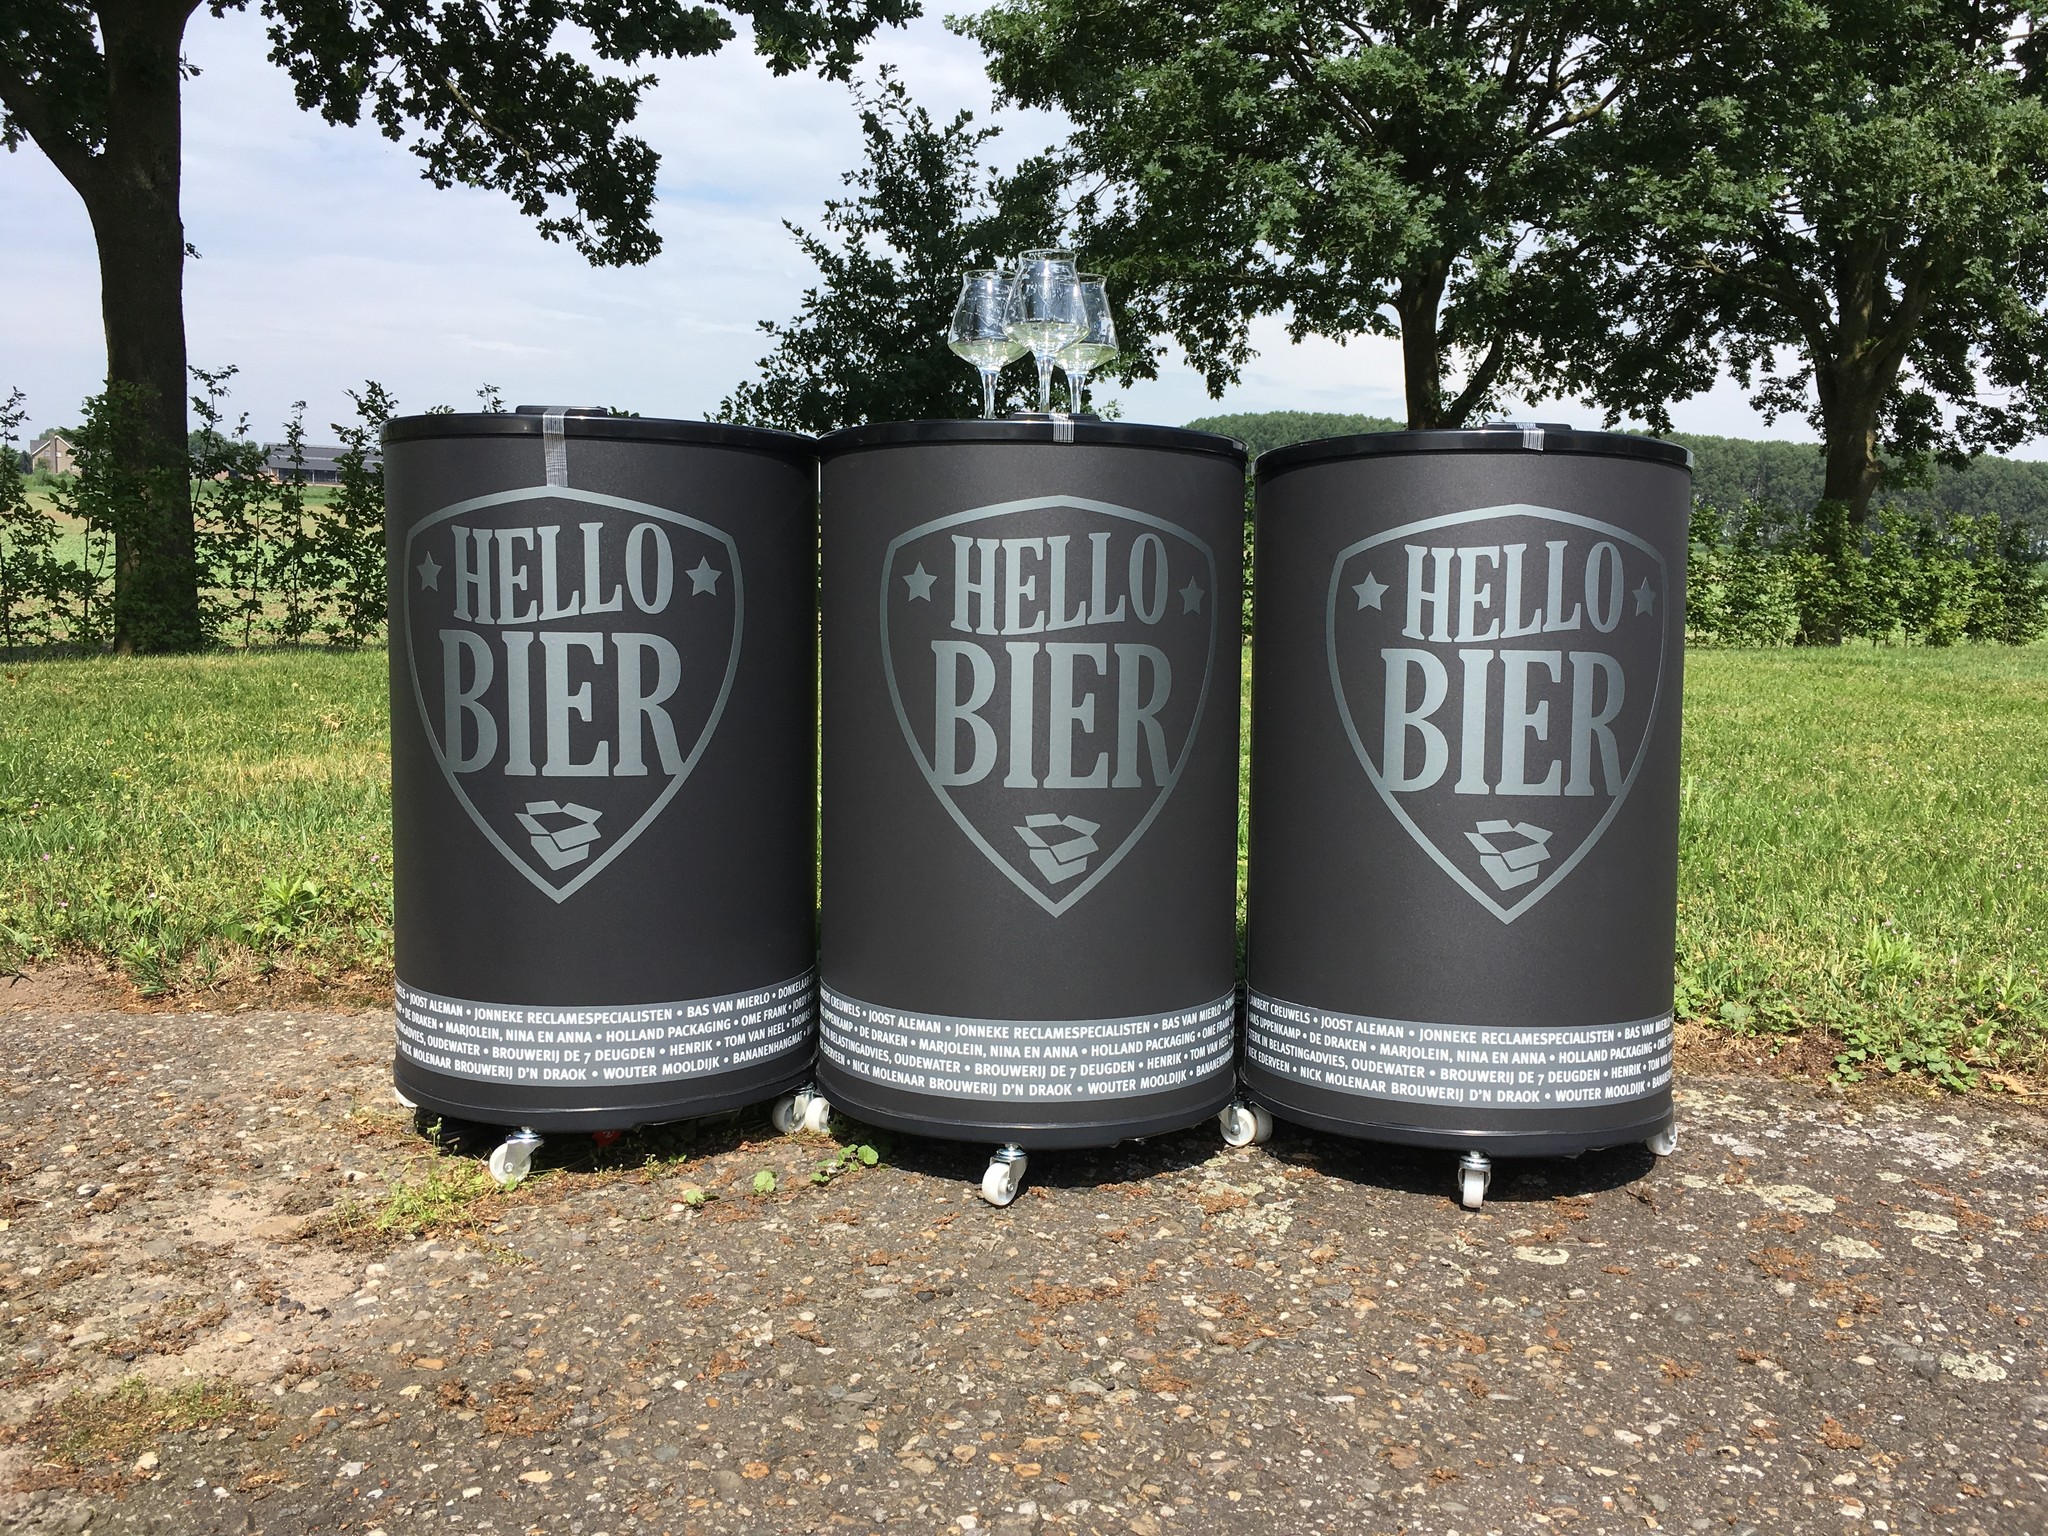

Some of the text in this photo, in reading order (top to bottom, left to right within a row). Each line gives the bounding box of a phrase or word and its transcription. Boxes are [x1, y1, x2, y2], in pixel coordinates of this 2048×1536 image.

[451, 522, 674, 625] HELLO
[950, 532, 1169, 636] HELLO
[1402, 540, 1625, 643] HELLO
[438, 629, 686, 777] BIER
[931, 640, 1173, 789] BIER
[1380, 648, 1626, 797] BIER
[409, 992, 428, 1009] JOOST
[429, 999, 463, 1017] ALEMAN
[687, 992, 770, 1019] BAS VAN MIERLO
[741, 1003, 788, 1027] OME FRANK
[1270, 1003, 1310, 1024] CREUWELS
[411, 1010, 437, 1030] DRAKEN
[474, 1008, 672, 1025] JONNEKE RECLAMESPECIALISTEN
[868, 1009, 941, 1033] JOOST ALEMAN
[1162, 1016, 1180, 1031] BAS
[1181, 1012, 1197, 1027] VAN
[1199, 1004, 1222, 1022] MIERLO
[1260, 1016, 1301, 1040] UPPENKAMP
[1320, 1016, 1404, 1039] JOOST ALEMAN
[446, 1021, 593, 1044] MARJOLEIN, NINA EN ANNA
[606, 1018, 731, 1043] HOLLAND PACKAGING
[724, 1022, 785, 1048] TOM VAN HEEL
[859, 1025, 908, 1048] DE DRAKEN
[955, 1021, 1150, 1040] JONNEKE RECLAMESPECIALISTEN
[1202, 1024, 1216, 1039] OME
[1309, 1031, 1367, 1053] DE DRAKEN
[1419, 1028, 1614, 1046] JONNEKE RECLAMESPECIALISTEN
[1624, 1025, 1640, 1040] BAS
[1641, 1022, 1655, 1037] VAN
[427, 1035, 481, 1057] OUDEWATER
[492, 1046, 655, 1065] BROUWERIJ DE 7 DEUGDEN
[669, 1040, 713, 1057] HENRIK
[733, 1030, 803, 1064] BANANENHANGMAT
[919, 1038, 1079, 1059] MARJOLEIN, NINA EN ANNA
[1091, 1031, 1196, 1057] HOLLAND PACKAGING
[1190, 1047, 1206, 1061] TOM
[1206, 1041, 1219, 1055] VAN
[1380, 1043, 1547, 1065] MARJOLEIN, NINA EN ANNA
[1558, 1048, 1609, 1064] HOLLAND
[1610, 1042, 1653, 1061] PACKAGING
[413, 1047, 451, 1070] MOLENAAR
[454, 1060, 514, 1080] BROUWERIJ
[543, 1068, 587, 1081] DRAOK
[894, 1052, 961, 1073] OUDEWATER
[1147, 1052, 1182, 1069] HENRIK
[1258, 1050, 1290, 1074] EDERVEEN
[1261, 1034, 1268, 1048] IN
[1268, 1037, 1349, 1071] BELASTINGADVIES,
[1351, 1058, 1425, 1078] OUDEWATER
[1648, 1057, 1661, 1072] TOM
[603, 1056, 720, 1080] WOUTER MOOLDIJK
[852, 1059, 870, 1076] NICK
[872, 1065, 925, 1087] MOLENAAR
[929, 1077, 997, 1097] BROUWERIJ
[1029, 1083, 1072, 1096] DRAOK
[974, 1060, 1135, 1079] BROUWERIJ DE 7 DEUGDEN
[1440, 1068, 1600, 1086] BROUWERIJ DE 7 DEUGDEN
[1611, 1062, 1642, 1079] HENRIK
[1088, 1069, 1187, 1095] WOUTER MOOLDIJK
[1299, 1065, 1322, 1082] NICK
[1325, 1071, 1386, 1093] MOLENAAR
[1391, 1082, 1464, 1101] BROUWERIJ
[1496, 1089, 1540, 1103] DRAOK
[1555, 1080, 1646, 1103] WOUTER MOOLDIJK
